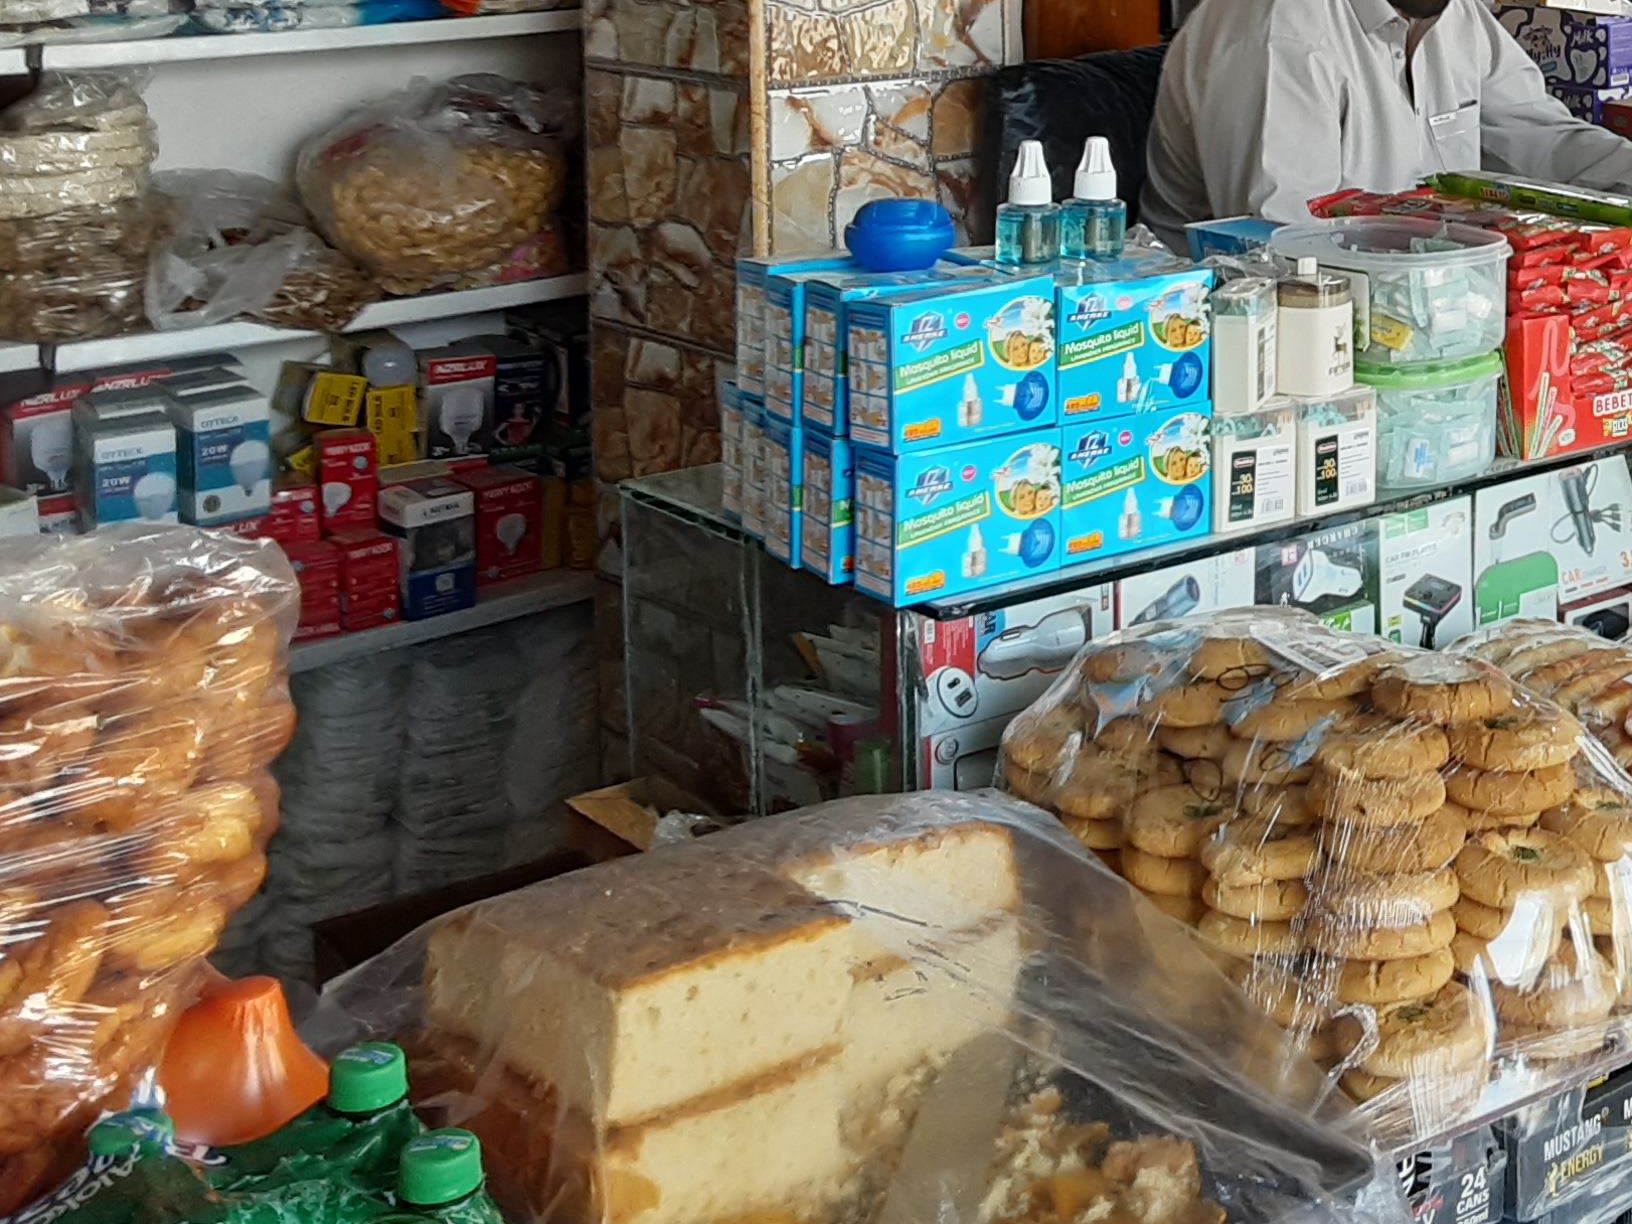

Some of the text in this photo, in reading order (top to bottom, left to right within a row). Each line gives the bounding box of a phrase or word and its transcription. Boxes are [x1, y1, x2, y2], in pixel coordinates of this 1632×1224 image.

[1064, 323, 1139, 355] Mosquito liquid
[899, 341, 978, 378] Mosquito liquid
[1066, 458, 1139, 495] Mosquito liquid
[903, 493, 984, 532] Mosquito liquid
[1561, 569, 1583, 584] CAR
[1544, 1114, 1601, 1163] MUSTANG
[1559, 1142, 1605, 1182] ENERGY
[1460, 1166, 1487, 1199] 24
[1456, 1187, 1490, 1216] CANS
